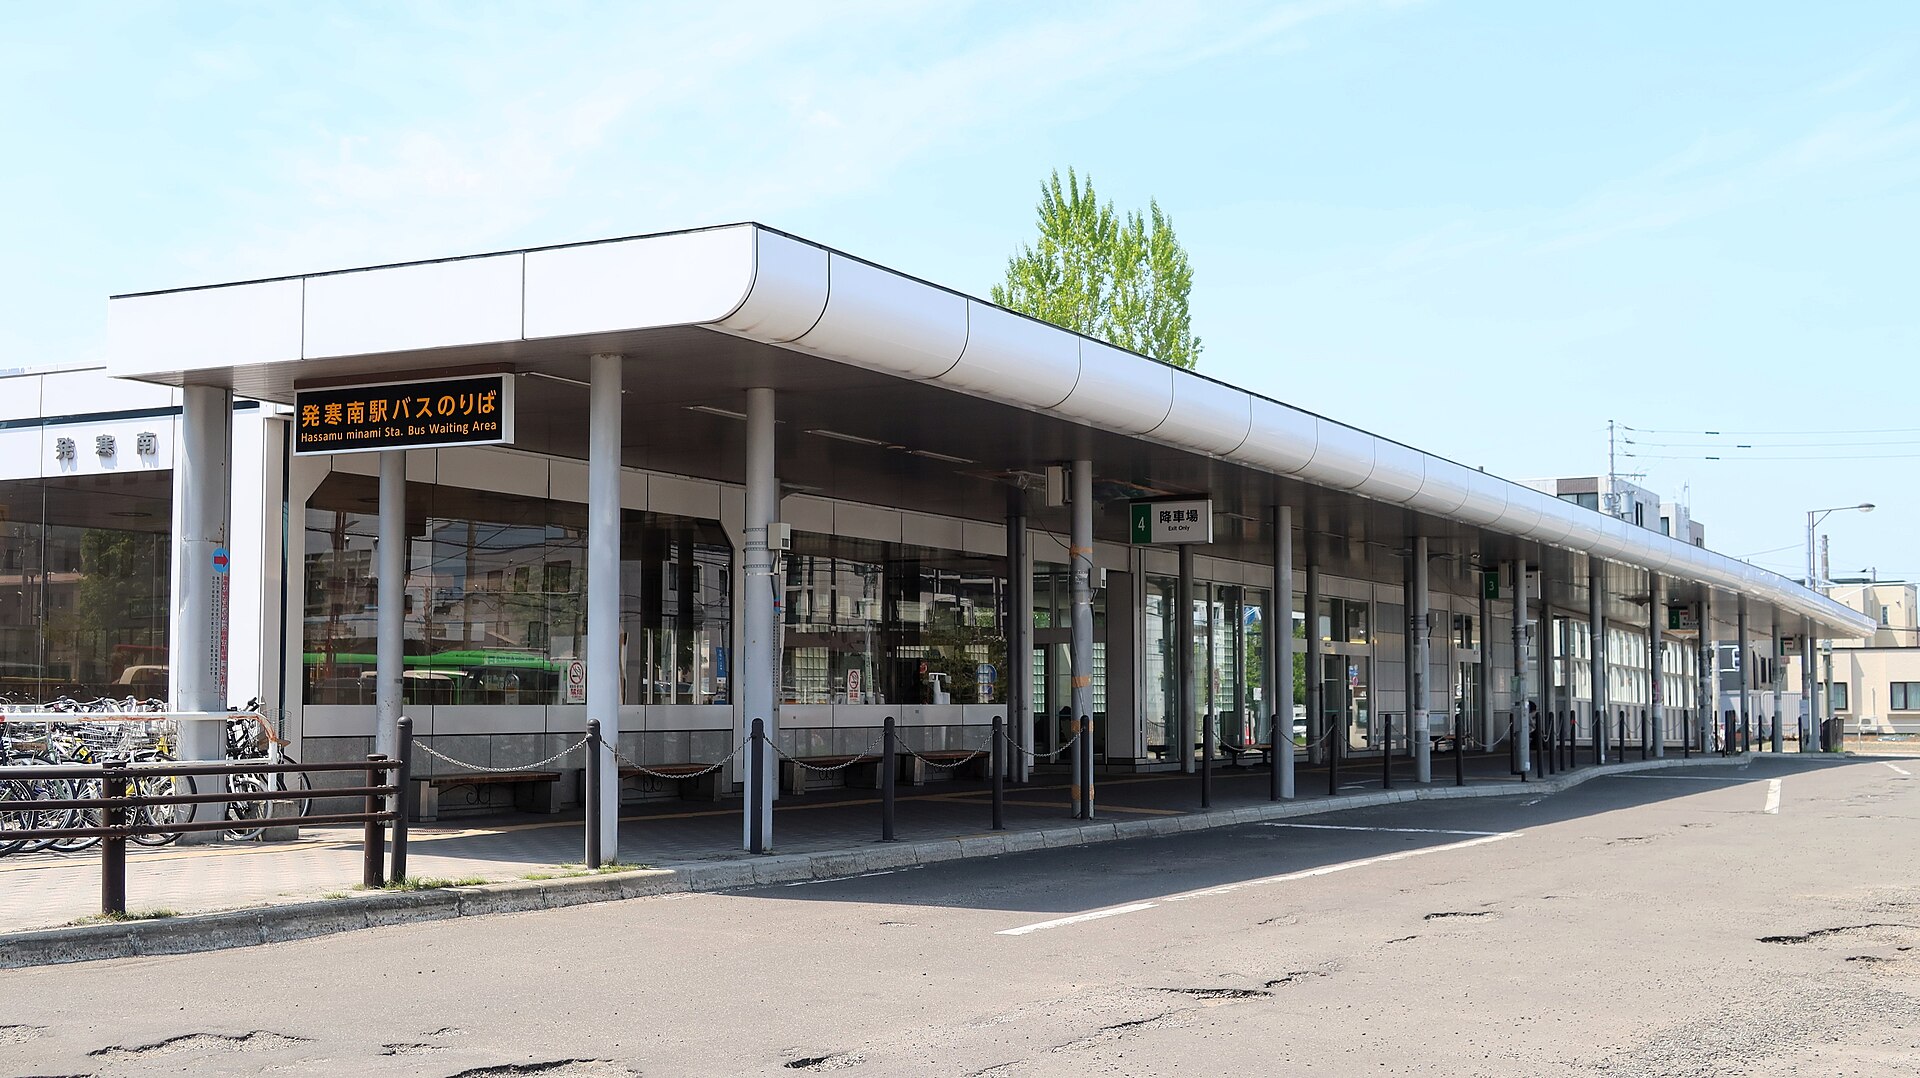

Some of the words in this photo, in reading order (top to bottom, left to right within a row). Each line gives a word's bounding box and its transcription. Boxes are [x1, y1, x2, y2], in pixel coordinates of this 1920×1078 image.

[301, 389, 498, 428] 発寒南駅バスのりば
[301, 431, 343, 443] Hassamu
[346, 429, 381, 440] minami
[384, 426, 404, 437] Sta.
[408, 425, 426, 435] Bus
[429, 422, 469, 435] Waiting
[472, 420, 497, 431] Area
[56, 431, 157, 460] 発寒南
[1137, 516, 1146, 532] 4
[1159, 509, 1199, 524] 降車場
[1489, 580, 1495, 591] 3
[1671, 615, 1677, 624] 2
